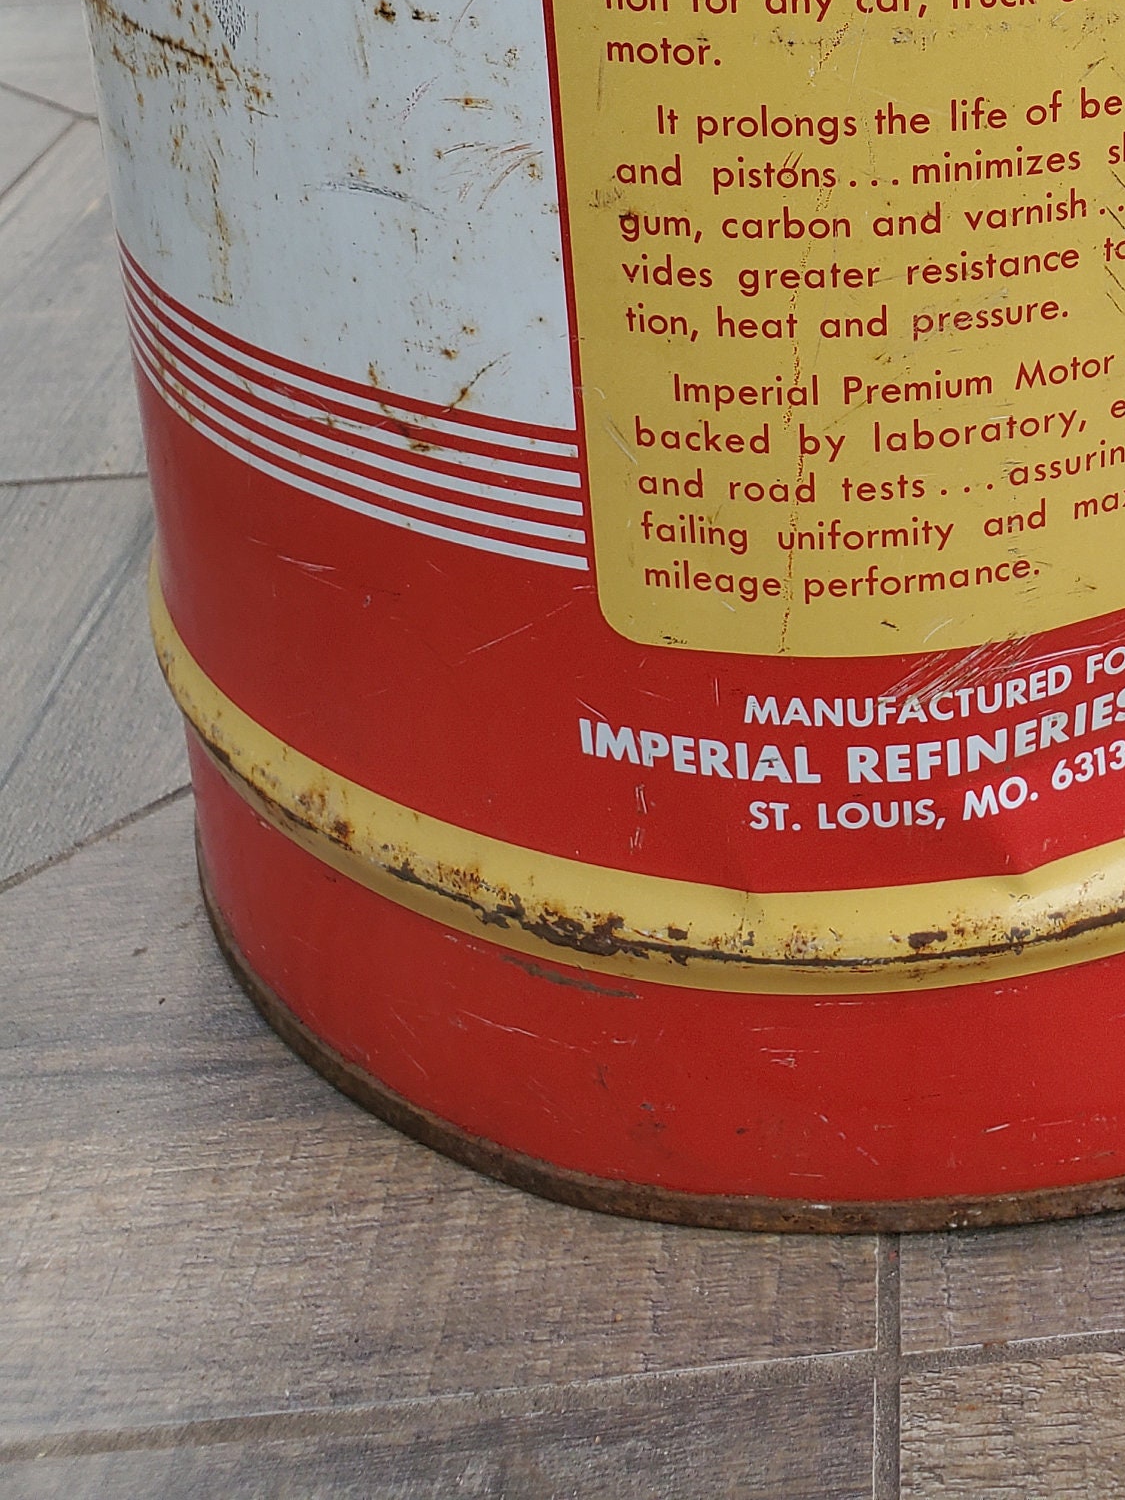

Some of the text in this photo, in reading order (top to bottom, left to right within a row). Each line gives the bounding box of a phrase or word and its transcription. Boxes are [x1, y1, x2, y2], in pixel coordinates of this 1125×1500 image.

[606, 37, 721, 67] motor.
[657, 104, 679, 135] It
[696, 104, 857, 146] prolongs
[874, 101, 931, 135] the
[950, 96, 1008, 132] life
[1025, 89, 1063, 126] of
[616, 153, 682, 187] and
[618, 209, 703, 244] gum,
[721, 205, 851, 240] carbon
[872, 201, 941, 237] and
[621, 253, 713, 288] vides
[738, 262, 881, 298] greater
[907, 249, 1080, 286] resistance
[625, 300, 1068, 343] tion, heat and pressure.
[673, 370, 819, 412] Imperial
[843, 369, 992, 405] Premium
[1015, 354, 1115, 391] Motor
[635, 415, 770, 454] backed
[798, 423, 846, 468] by
[874, 409, 1087, 453] laboratory,
[638, 467, 704, 499] and
[729, 467, 816, 503] road
[640, 510, 748, 556] failing
[777, 516, 954, 551] uniformity
[983, 497, 1046, 537] and
[644, 559, 1040, 605] mileage performance.
[743, 663, 1074, 729] MANUFACTURED
[579, 718, 822, 784] IMPERIAL
[749, 801, 801, 831] ST.
[817, 798, 946, 830] LOUIS,
[962, 776, 1039, 821] MO.
